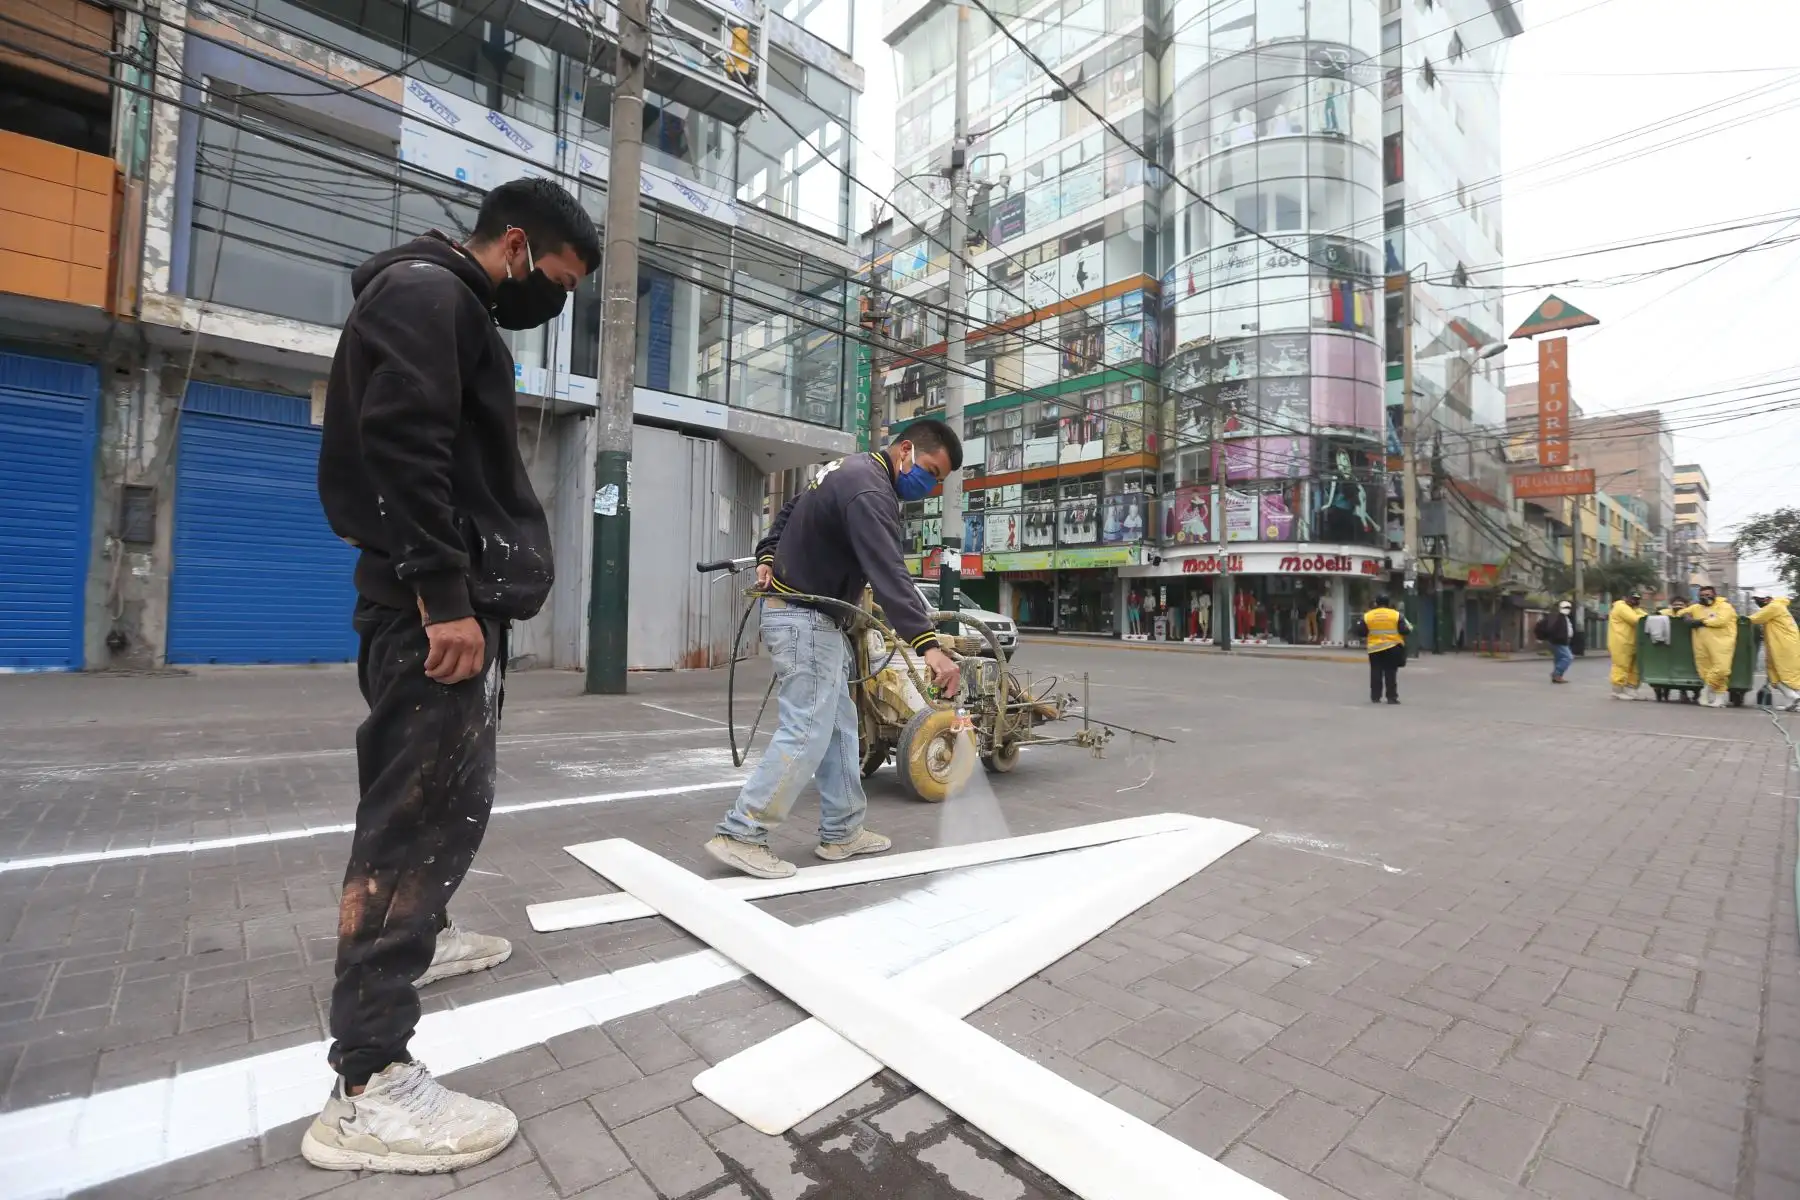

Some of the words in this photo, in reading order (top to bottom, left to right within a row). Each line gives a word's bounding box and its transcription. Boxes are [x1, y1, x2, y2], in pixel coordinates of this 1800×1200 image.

[1266, 255, 1303, 270] 409
[1546, 342, 1560, 369] LA
[1545, 382, 1562, 463] TORRE
[1279, 554, 1353, 572] Modelli
